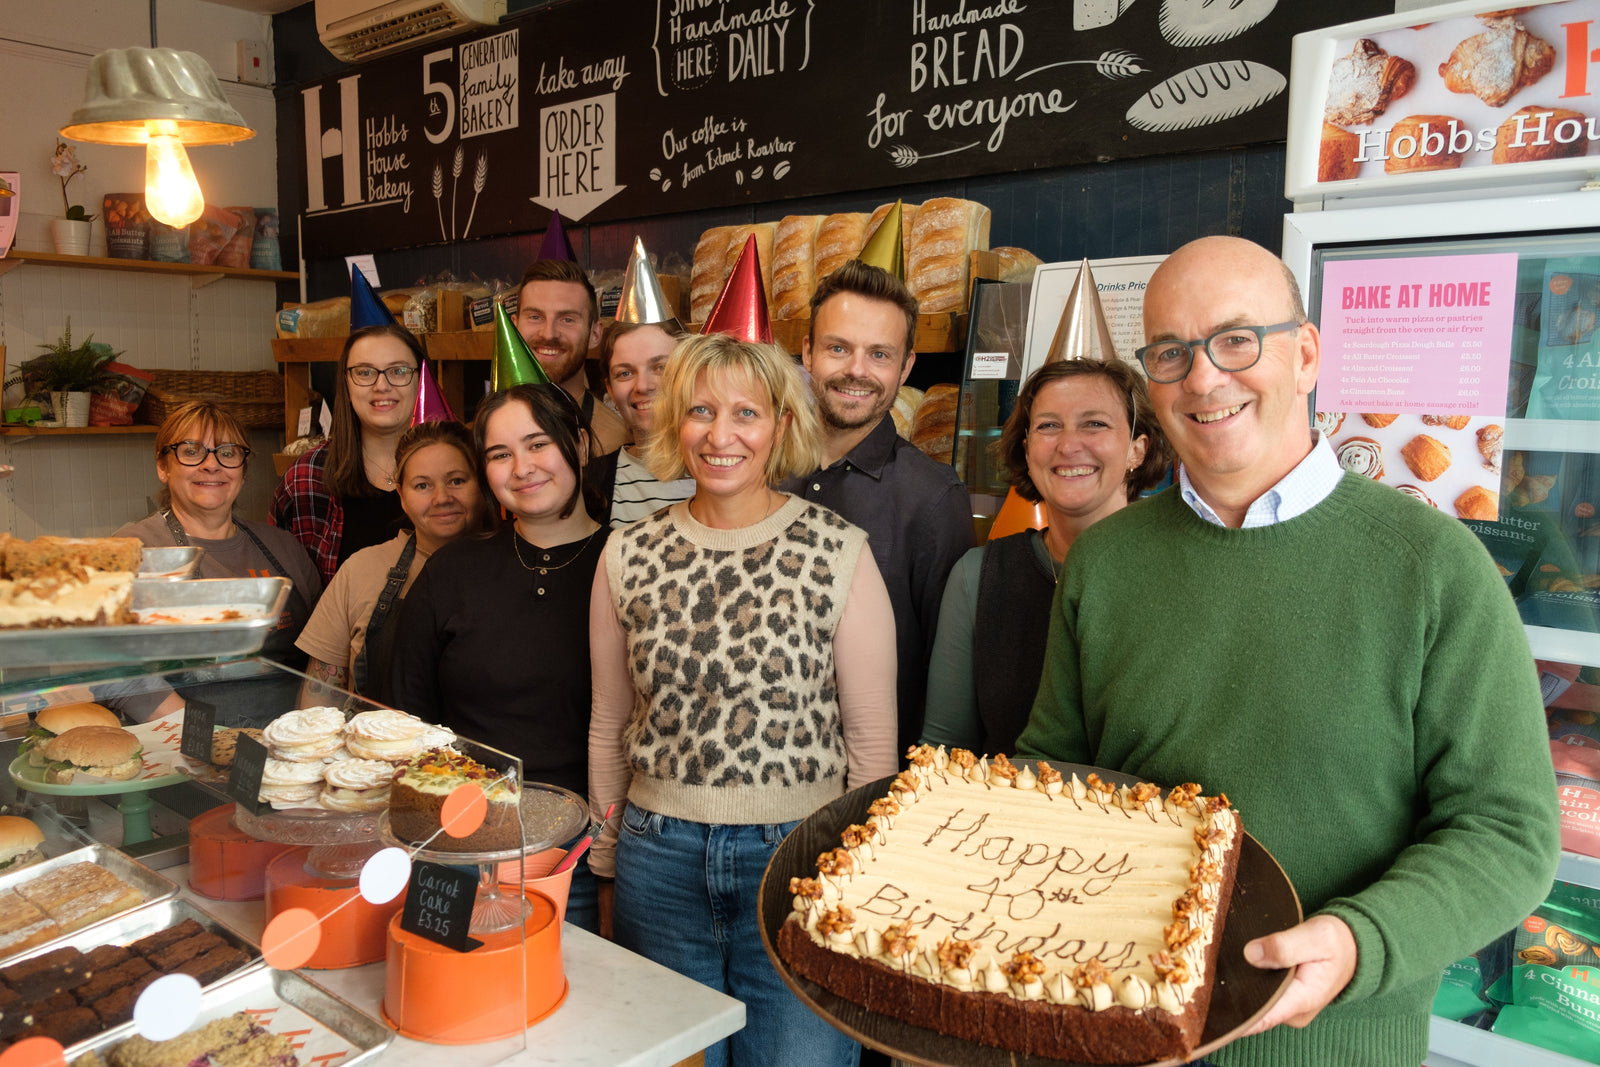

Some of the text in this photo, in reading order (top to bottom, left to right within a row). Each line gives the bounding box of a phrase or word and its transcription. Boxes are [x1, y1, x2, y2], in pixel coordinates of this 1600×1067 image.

[668, 0, 796, 45] Handmade
[912, 0, 1027, 35] Handmade
[461, 31, 519, 71] GENERATION
[677, 20, 790, 83] HERE DAILY
[911, 23, 1024, 93] BREAD
[461, 65, 516, 106] family
[535, 55, 632, 95] take away
[366, 114, 409, 151] Hobbs
[461, 95, 515, 135] BAKERY
[545, 103, 605, 153] ORDER
[867, 89, 1077, 152] for everyone
[662, 115, 748, 160] Our coffee is
[1352, 120, 1498, 163] Hobbs
[367, 151, 410, 178] House
[547, 148, 603, 199] HERE
[681, 136, 796, 188] from Extract Roasters
[367, 175, 415, 214] Bakery
[1097, 282, 1126, 292] Drinks
[1341, 282, 1491, 310] BAKE AT HOME
[1342, 327, 1375, 335] straight
[1398, 326, 1412, 334] the
[1413, 326, 1434, 334] oven
[1447, 325, 1459, 333] air
[1461, 325, 1485, 335] fryer
[1345, 316, 1366, 325] Tuck
[1367, 316, 1384, 324] into
[1411, 315, 1434, 325] pizza
[1446, 314, 1483, 324] pastries
[1563, 353, 1575, 369] 4
[1559, 373, 1600, 391] Croi
[1339, 399, 1354, 407] Ask
[1354, 399, 1375, 407] about
[1404, 400, 1425, 408] home
[1427, 402, 1457, 410] sausage
[1498, 514, 1541, 531] utter
[924, 808, 1138, 897] Happy
[418, 865, 460, 899] Carrot
[420, 889, 451, 914] Cake
[967, 877, 1084, 921] 40th
[417, 908, 452, 937] £3.25
[856, 883, 1141, 970] Birthday
[1524, 969, 1537, 980] 4
[1570, 967, 1590, 983] H
